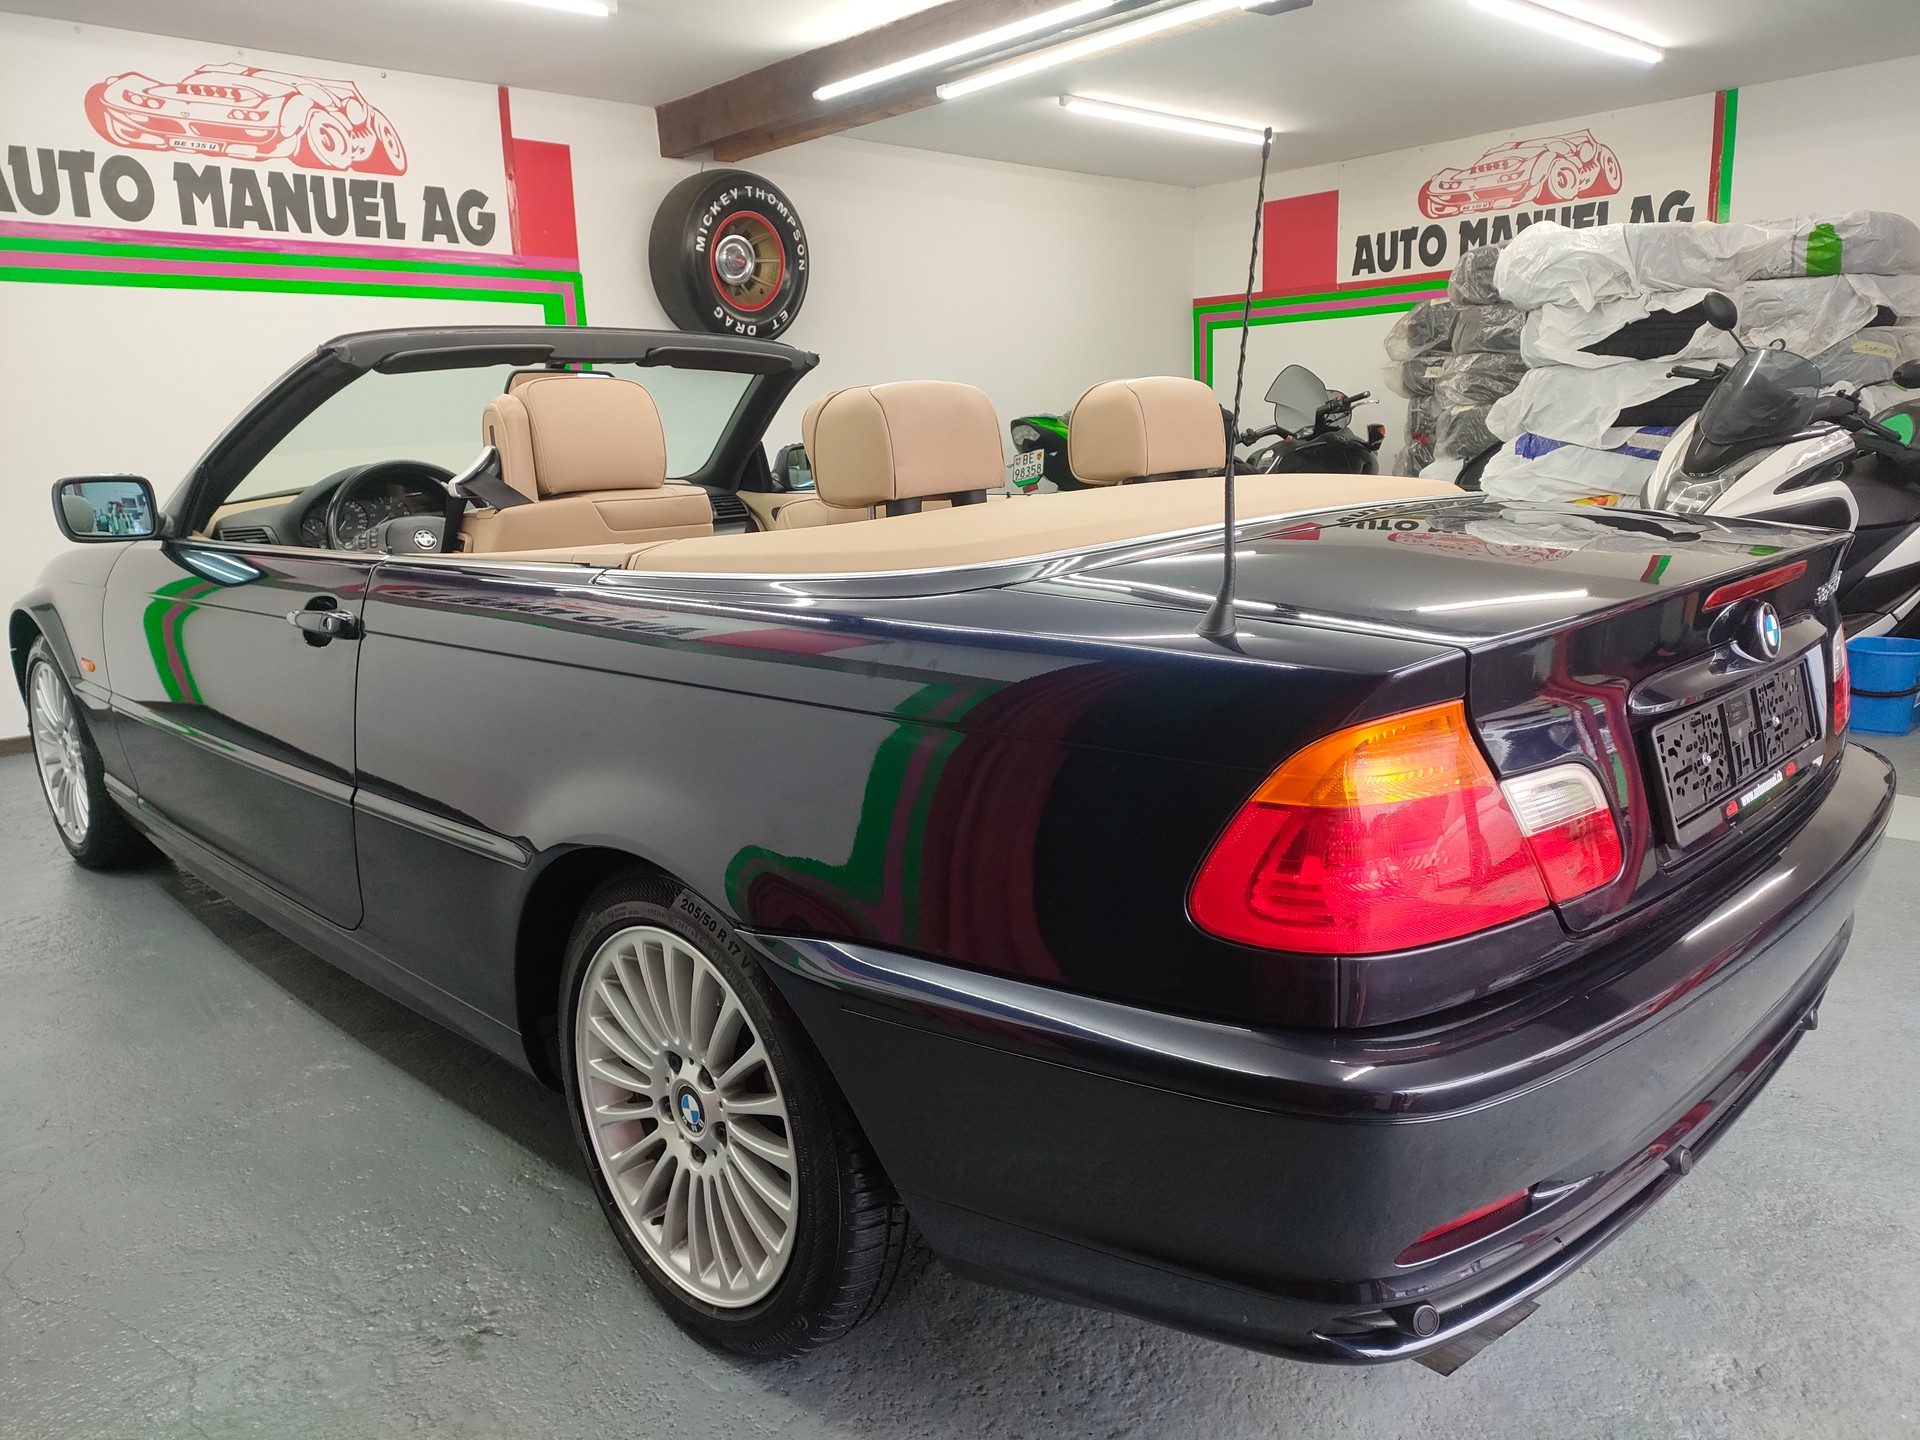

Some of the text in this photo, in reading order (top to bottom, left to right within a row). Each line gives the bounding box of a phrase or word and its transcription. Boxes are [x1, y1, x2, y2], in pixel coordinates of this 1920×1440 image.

[0, 145, 496, 247] UTO MANUEL AG
[695, 185, 805, 271] MICKEY THOMPSON
[1352, 224, 1447, 276] AUTO
[1629, 190, 1695, 223] AG
[713, 305, 789, 336] ET DRAG
[1014, 463, 1042, 480] 98358
[1022, 452, 1035, 466] BE
[680, 897, 717, 932] 205/50
[716, 927, 728, 944] R
[727, 940, 742, 956] 17
[740, 955, 752, 969] V
